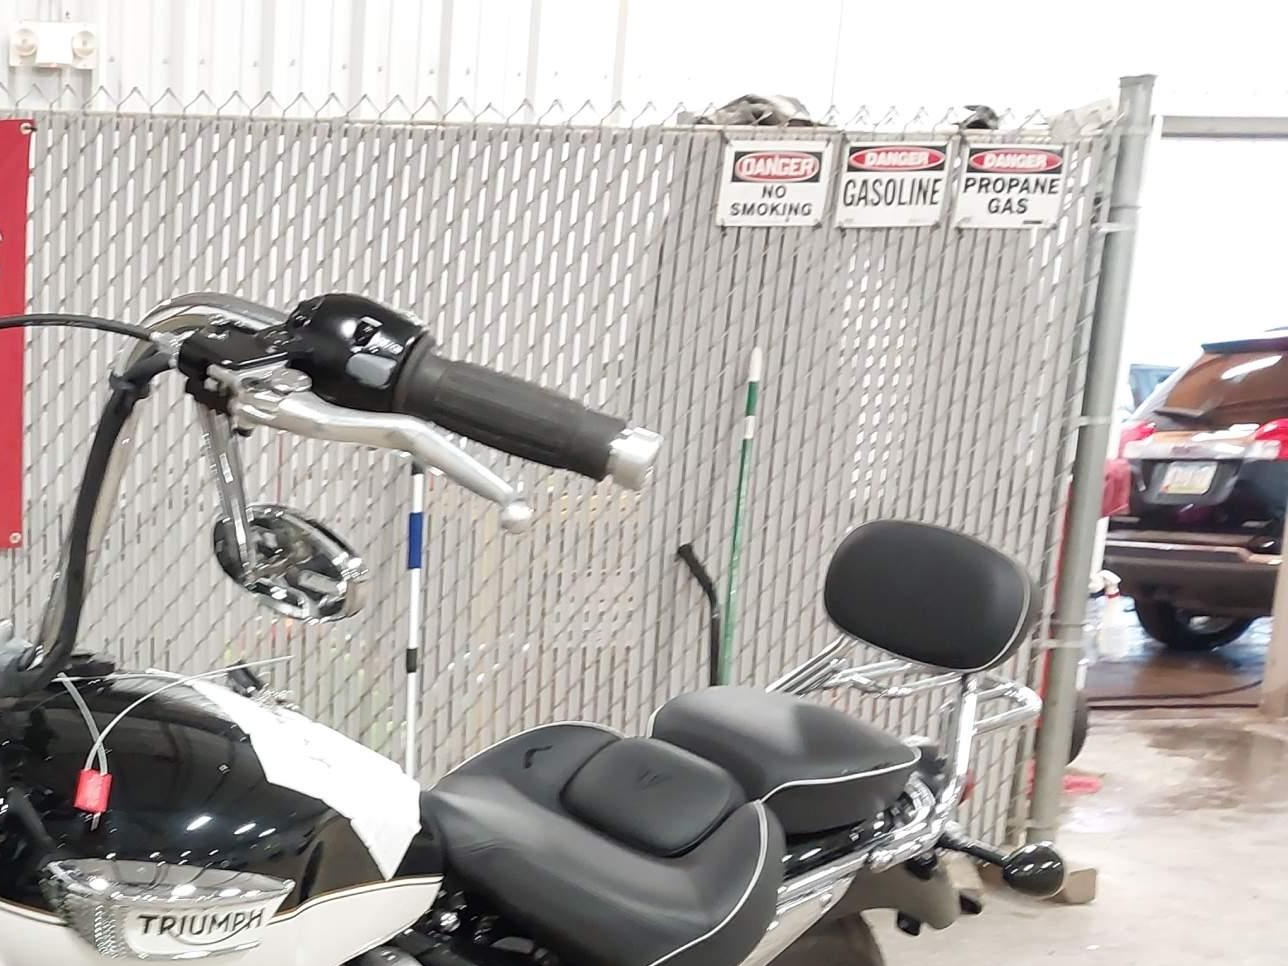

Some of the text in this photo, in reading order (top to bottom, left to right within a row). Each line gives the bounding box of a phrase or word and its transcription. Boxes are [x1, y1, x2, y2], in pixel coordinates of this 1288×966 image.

[740, 155, 815, 177] DANGER
[864, 151, 930, 168] DANGER
[982, 153, 1048, 169] DANGER
[761, 185, 787, 199] NO
[843, 178, 943, 207] GASOLINE
[962, 177, 1061, 194] PROPANE
[730, 202, 813, 217] SMOKING
[987, 197, 1029, 214] GAS
[137, 907, 265, 936] TRIUMPH
